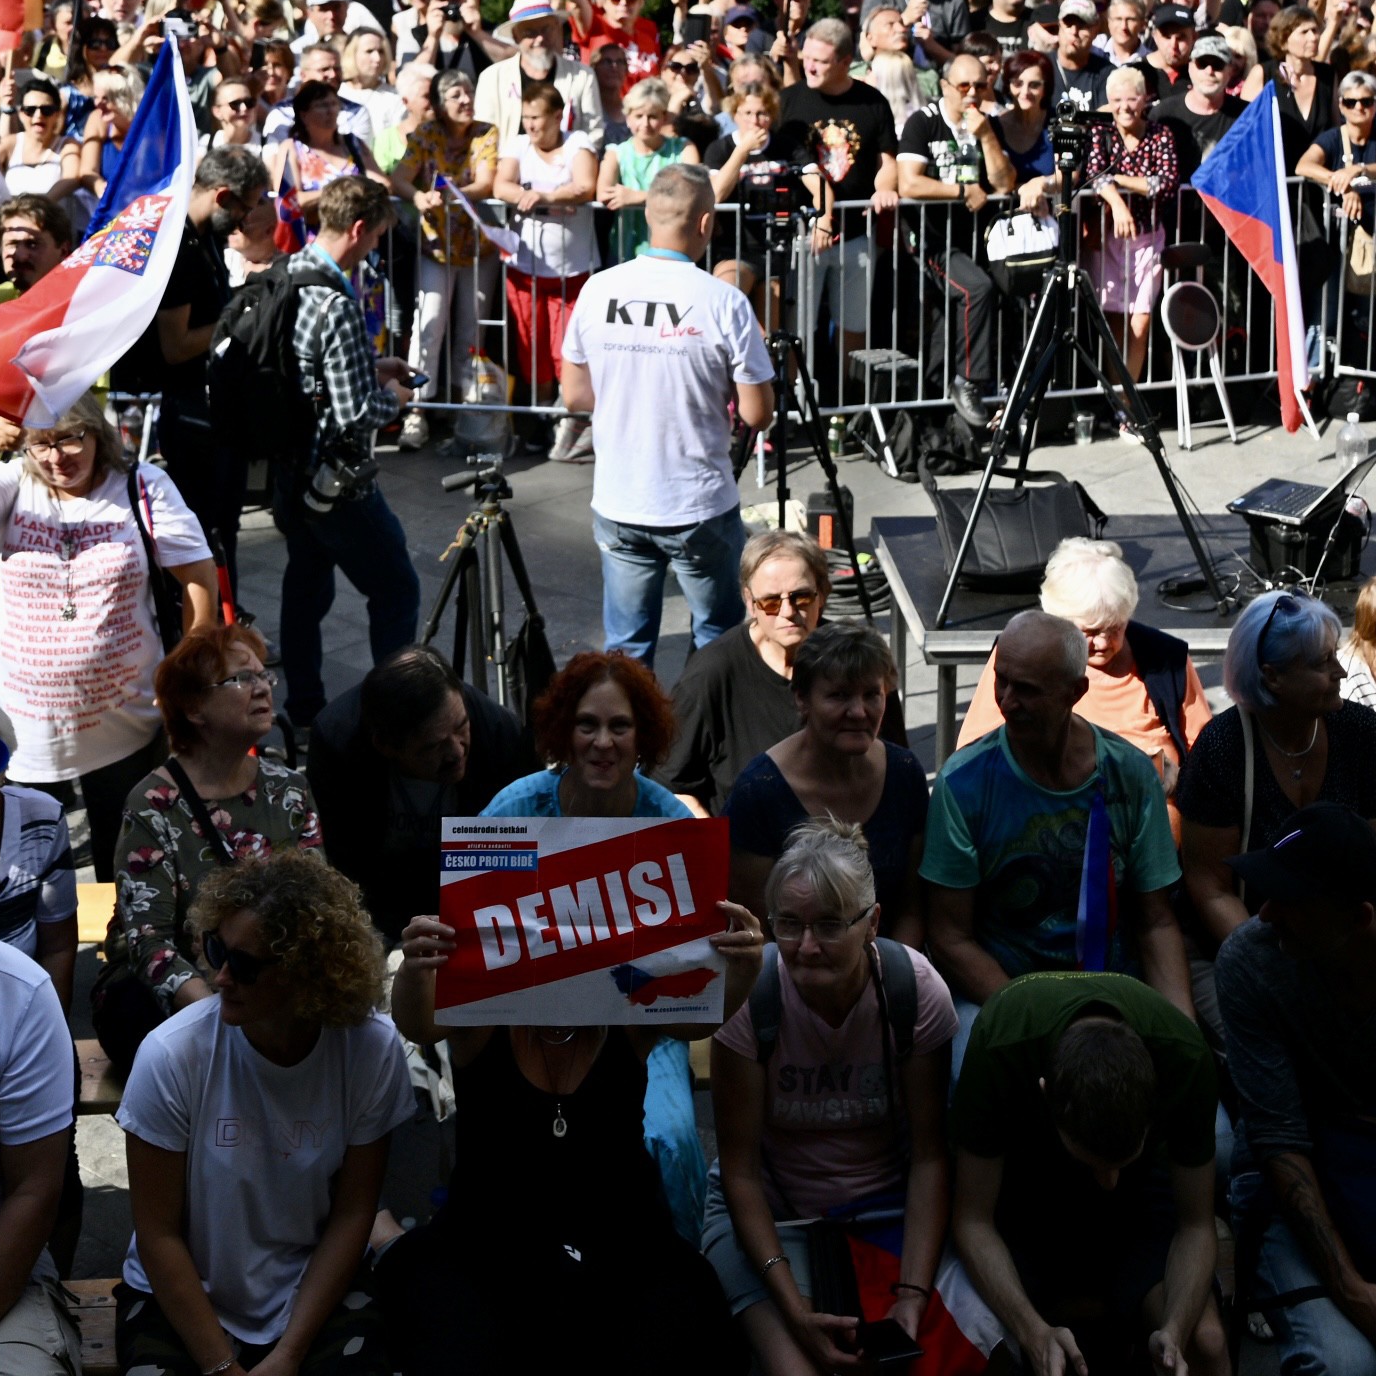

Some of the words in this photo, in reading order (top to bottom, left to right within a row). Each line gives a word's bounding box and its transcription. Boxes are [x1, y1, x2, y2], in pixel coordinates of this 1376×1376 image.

[606, 298, 694, 328] KTV
[660, 322, 703, 339] Live
[445, 853, 477, 868] ČESKO
[479, 854, 508, 867] PROTI
[510, 853, 533, 867] BÍDĚ
[473, 851, 696, 971] DEMISI
[777, 1064, 853, 1095] STAY
[216, 1118, 332, 1150] DNY
